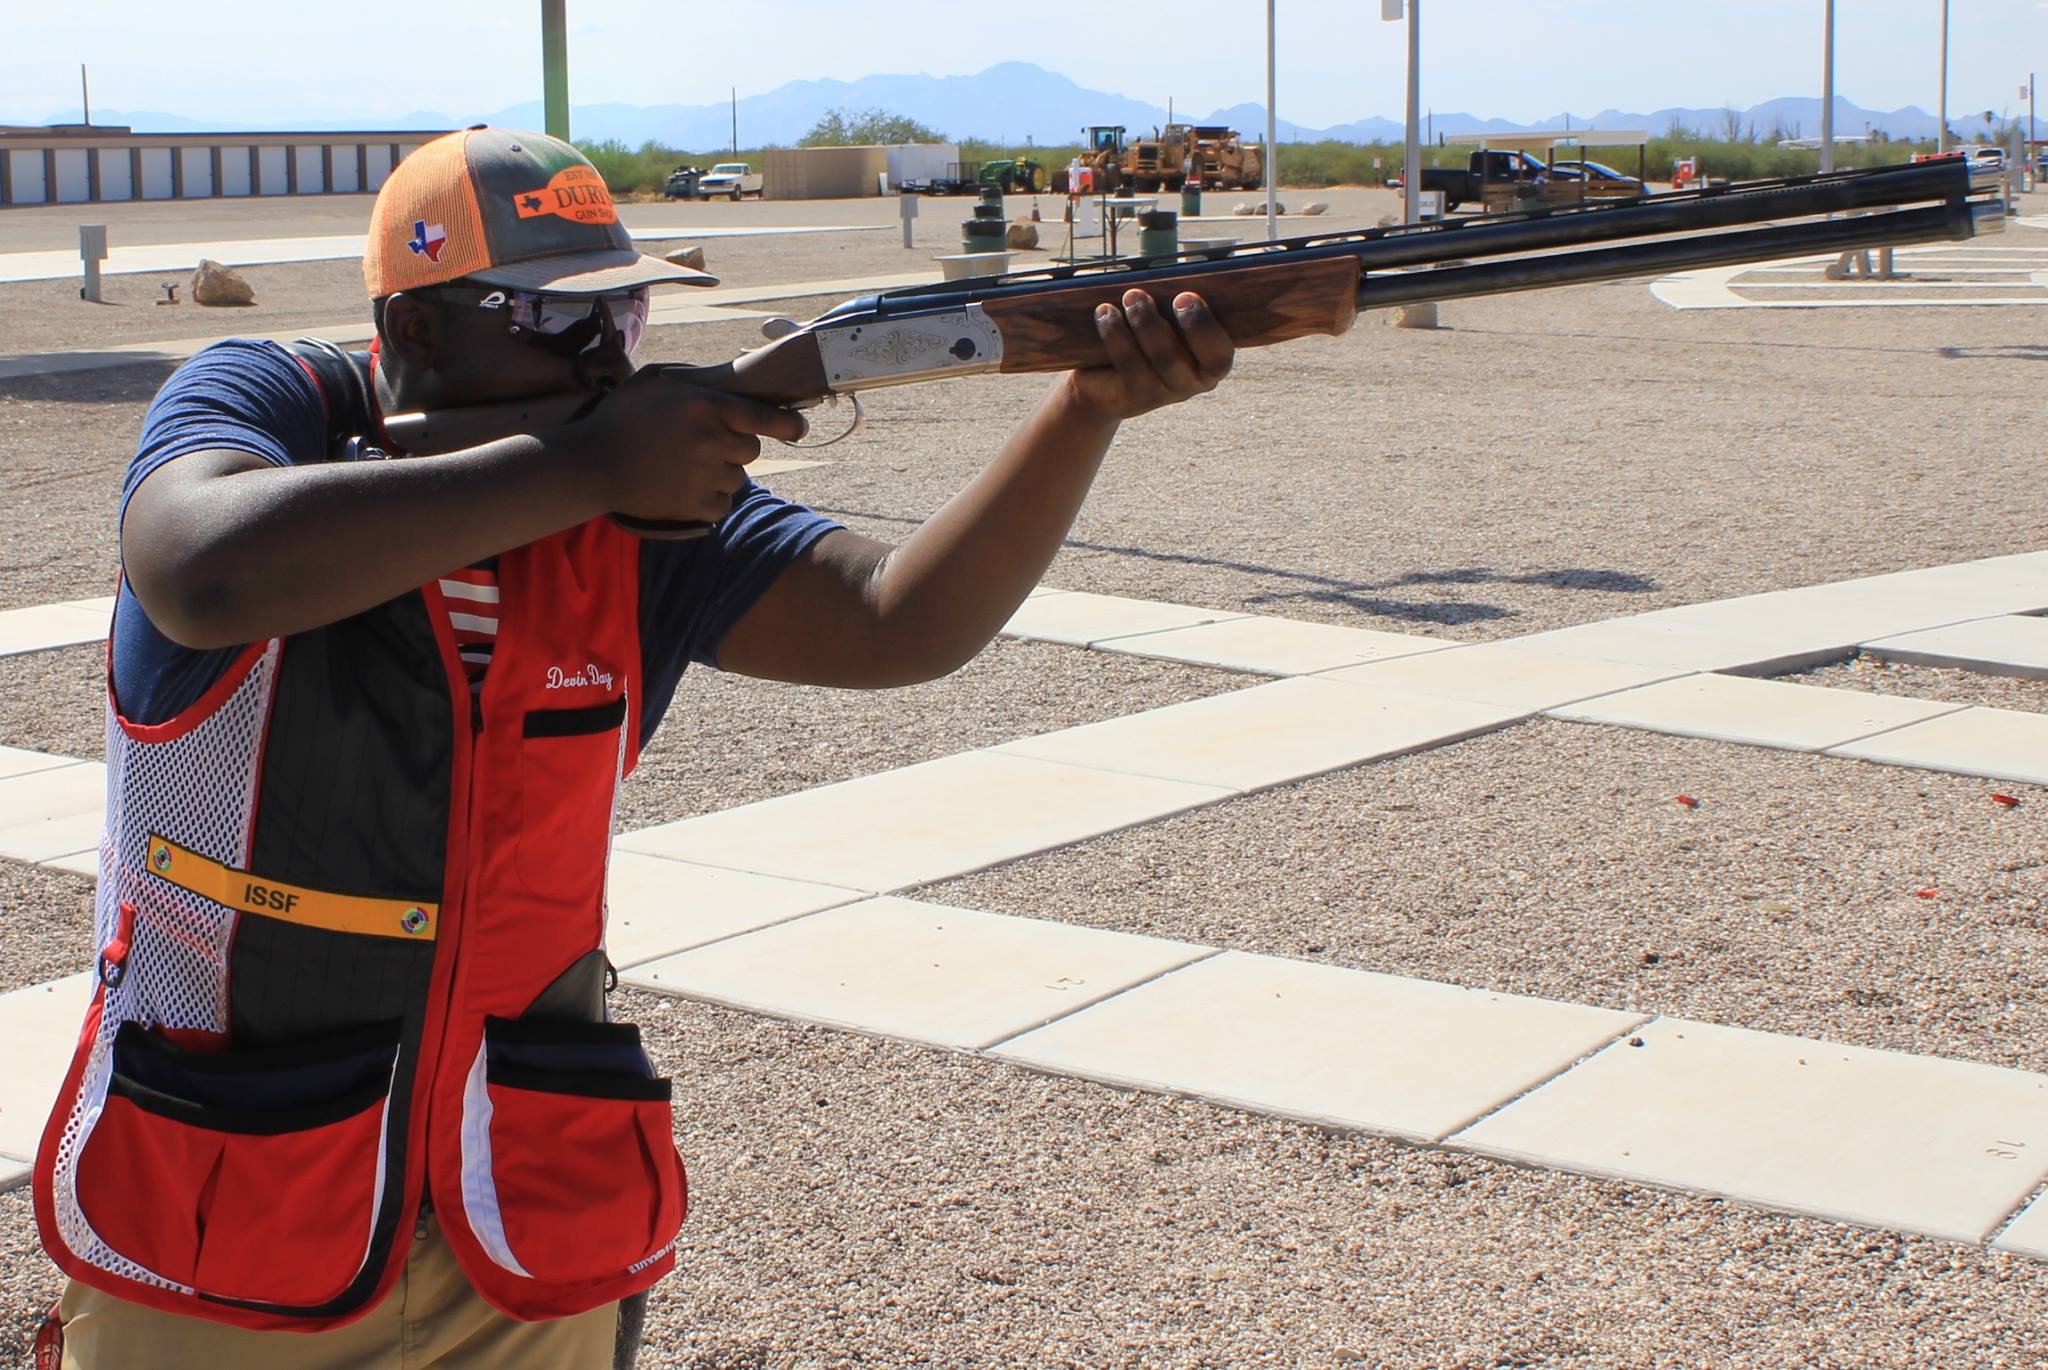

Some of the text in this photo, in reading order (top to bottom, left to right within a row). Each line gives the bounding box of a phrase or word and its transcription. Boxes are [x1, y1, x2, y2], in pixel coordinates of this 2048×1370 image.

[575, 208, 597, 221] GUN
[546, 664, 613, 691] Devin Day
[244, 883, 300, 913] ISSF
